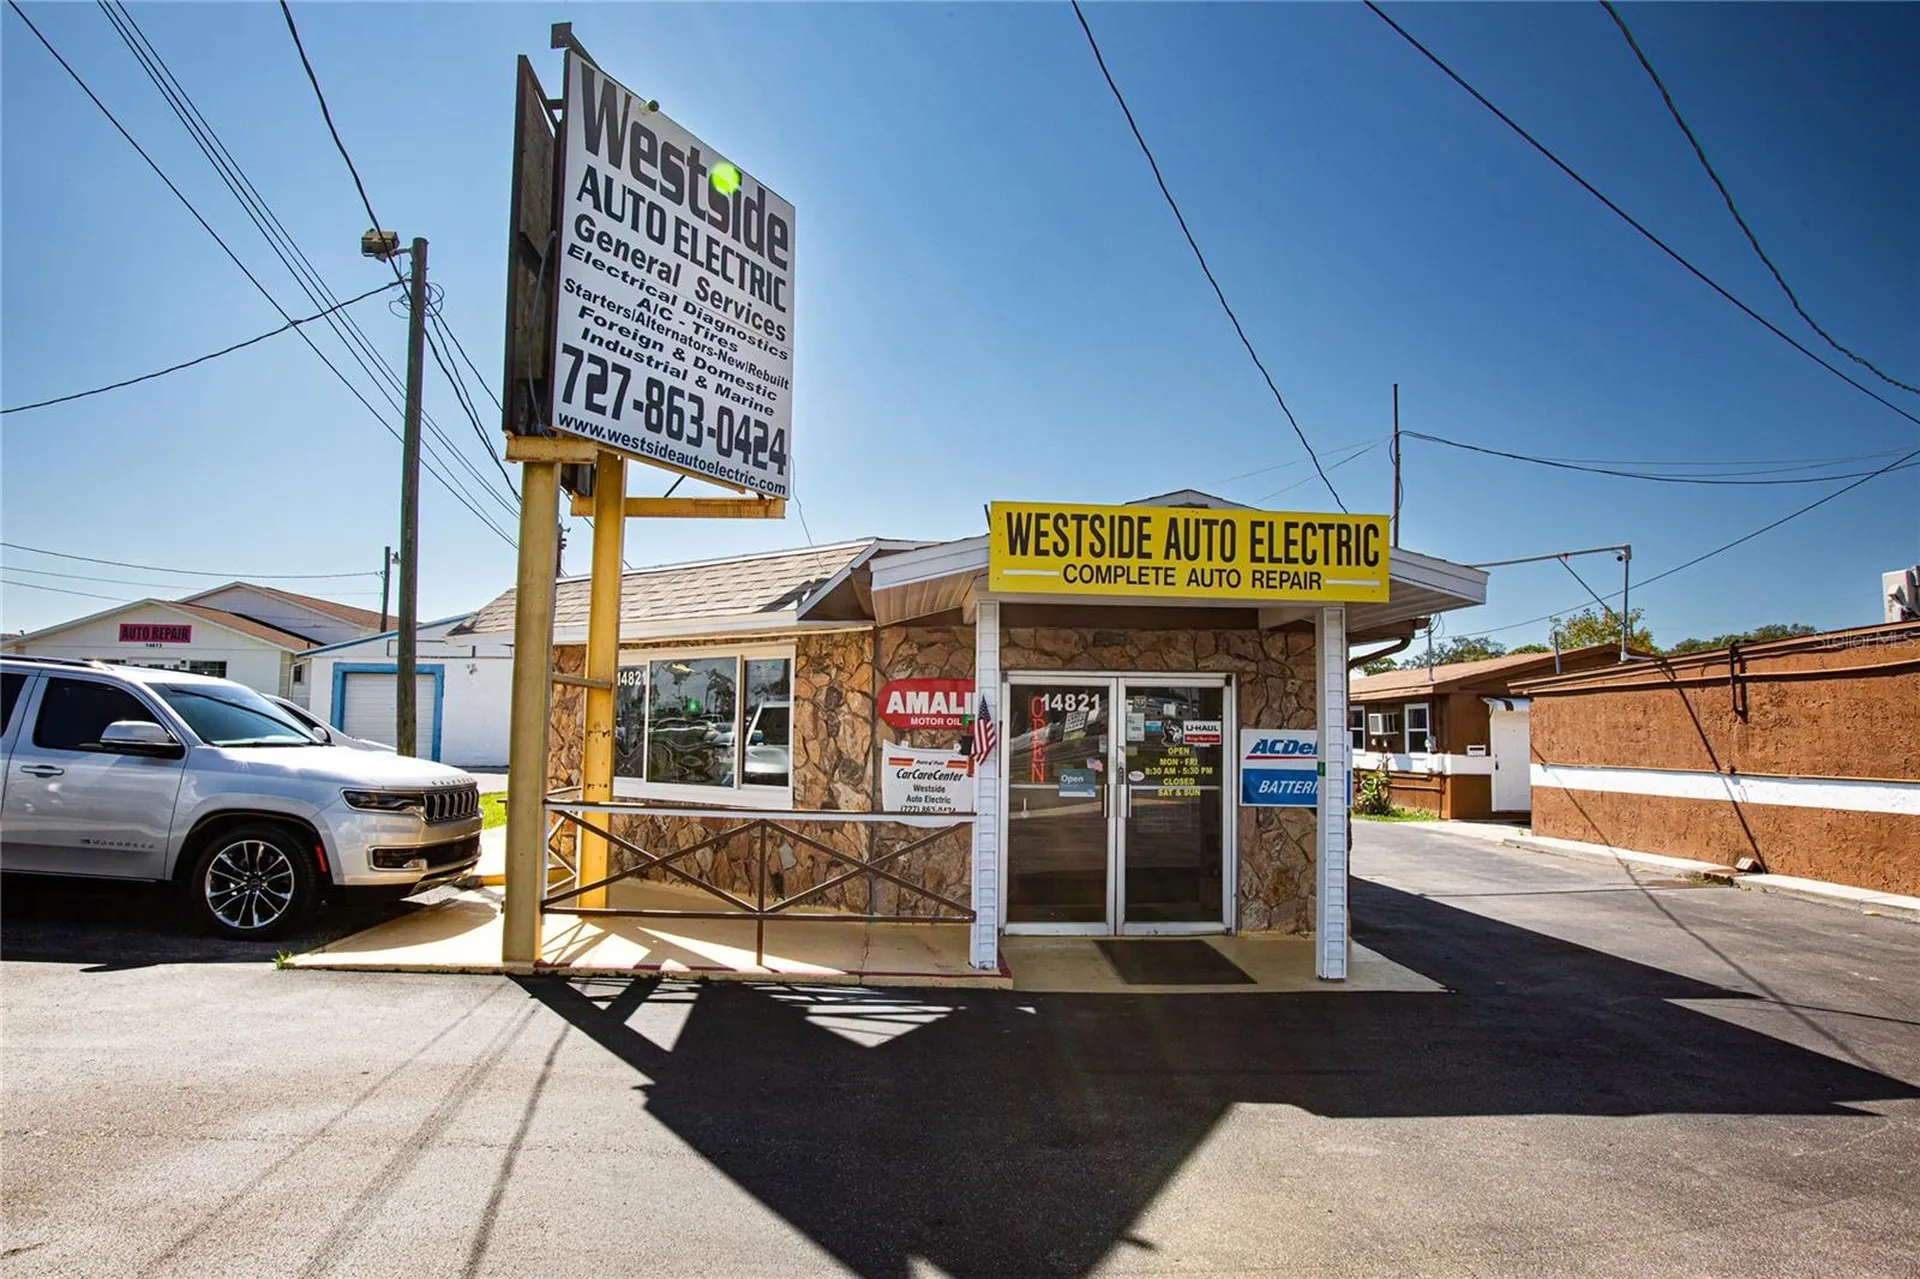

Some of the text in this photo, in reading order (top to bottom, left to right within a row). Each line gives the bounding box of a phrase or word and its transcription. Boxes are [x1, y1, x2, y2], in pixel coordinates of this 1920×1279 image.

[581, 62, 788, 271] Westside
[576, 164, 787, 313] AUTO ELECTRIC
[575, 213, 787, 342] General Services
[567, 243, 788, 360] Electrical Diagnostics
[637, 298, 674, 321] A/C
[693, 321, 738, 352] Tires
[578, 305, 778, 401] Foreign & Domestic
[581, 328, 775, 417] Industrial & Marine
[562, 343, 787, 476] 727-863-0424
[559, 412, 787, 495] www.westsideautoelectric.com
[1006, 511, 1380, 567] WESTSIDE AUTO ELECTRIC
[1063, 563, 1322, 590] COMPLETE AUTO REPAIR
[122, 626, 189, 641] AUTO REPAIR
[1041, 693, 1100, 711] 14821
[911, 717, 962, 726] MOTOR OIL
[1168, 747, 1190, 755] OPEN
[1185, 758, 1198, 766] FRI
[1061, 774, 1084, 784] Open
[1164, 767, 1176, 775] AM
[906, 795, 951, 804] Auto Electric
[913, 784, 946, 793] Westside
[1158, 788, 1172, 796] SAT
[1184, 788, 1200, 796] SUN
